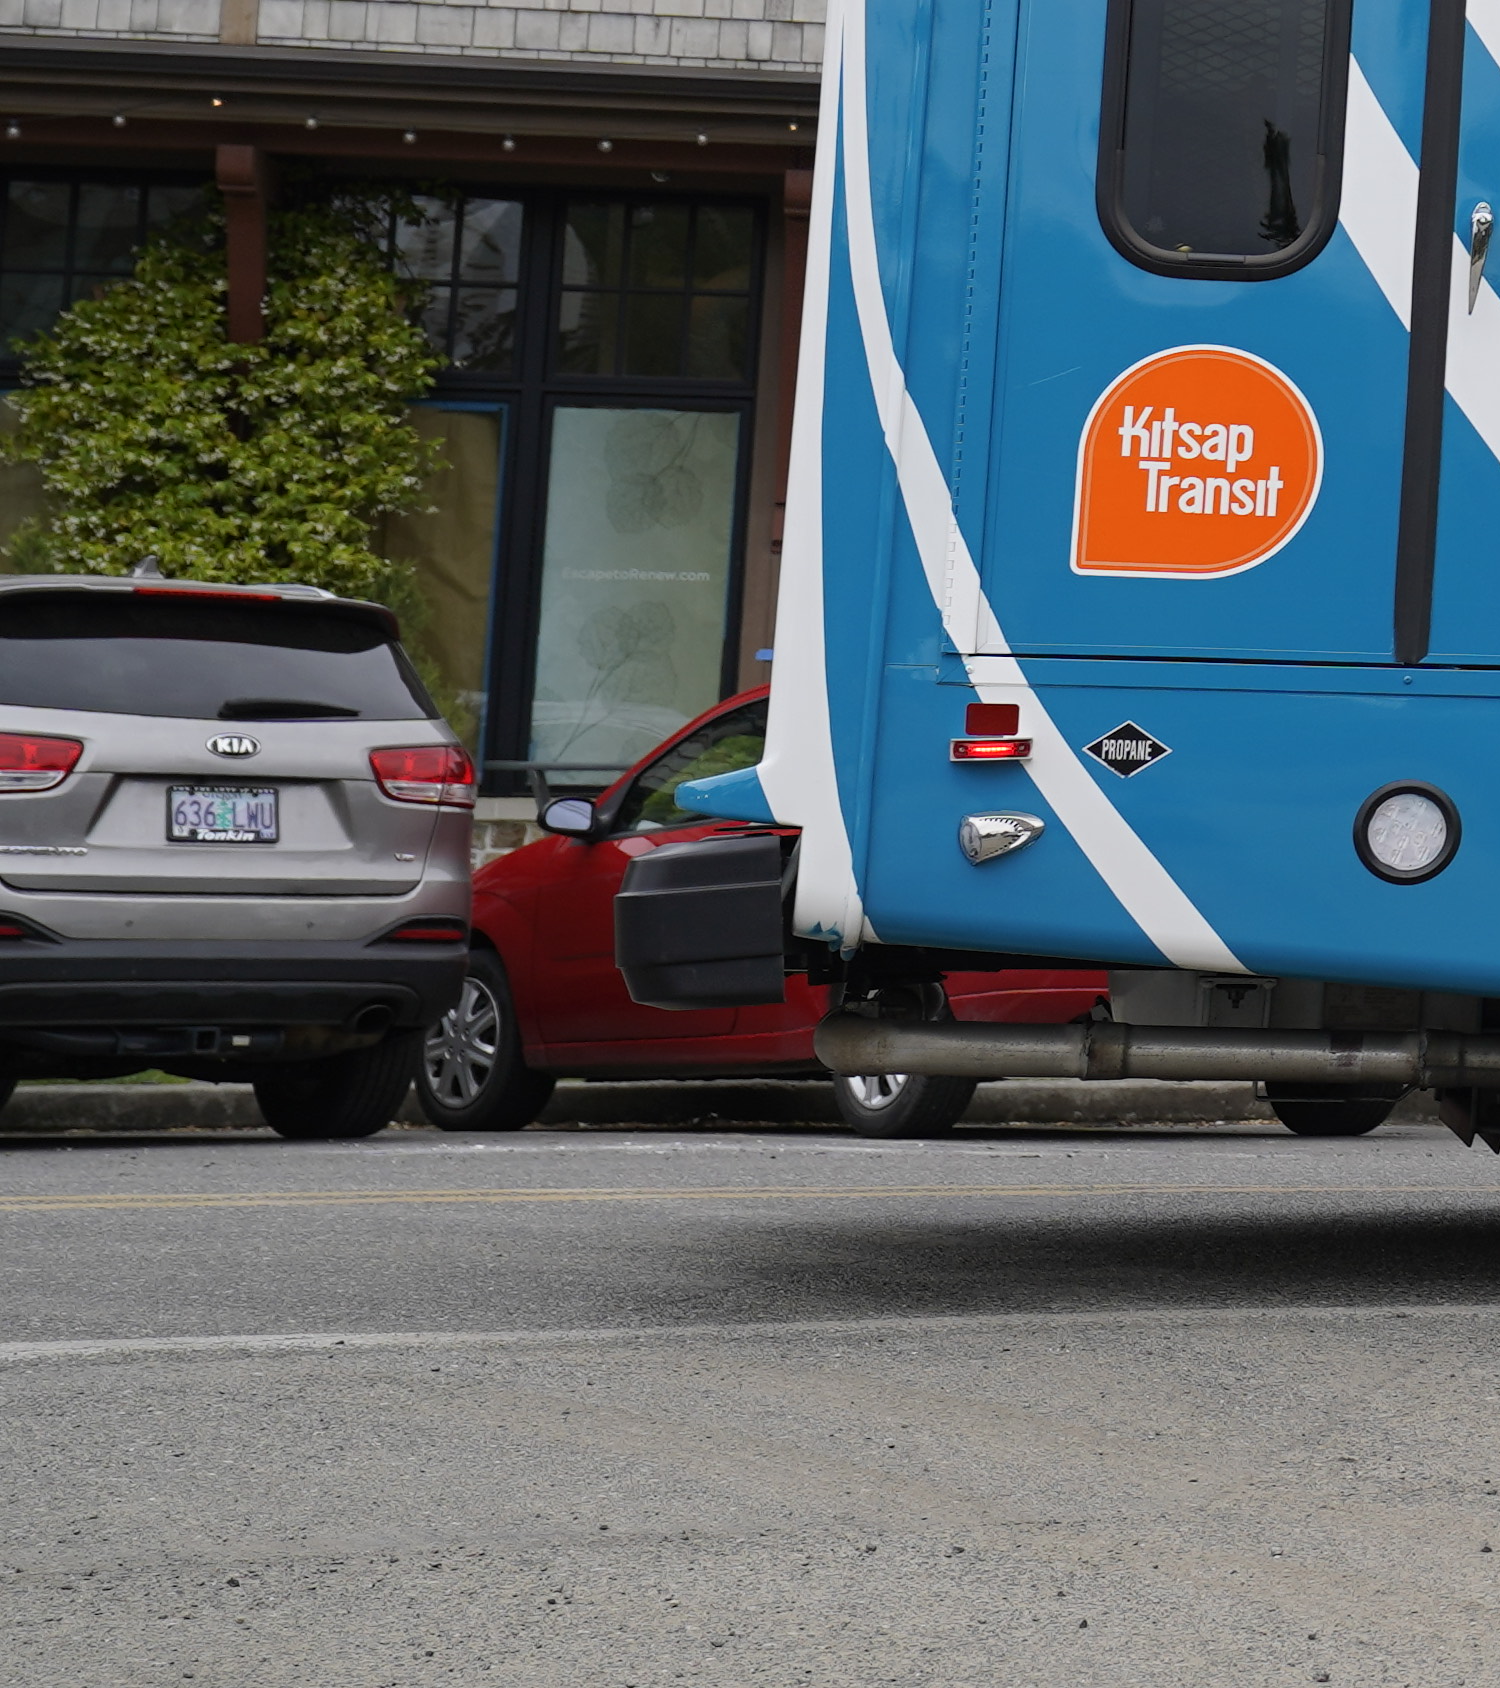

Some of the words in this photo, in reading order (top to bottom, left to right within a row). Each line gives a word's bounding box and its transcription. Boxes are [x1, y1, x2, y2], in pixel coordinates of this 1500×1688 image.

[1119, 406, 1254, 472] Kitsap
[1139, 460, 1284, 517] Transit
[216, 737, 255, 754] KIA
[1101, 738, 1153, 762] PROPANE
[174, 800, 217, 828] 636
[231, 801, 274, 830] LWU
[197, 829, 256, 842] Tonkin
